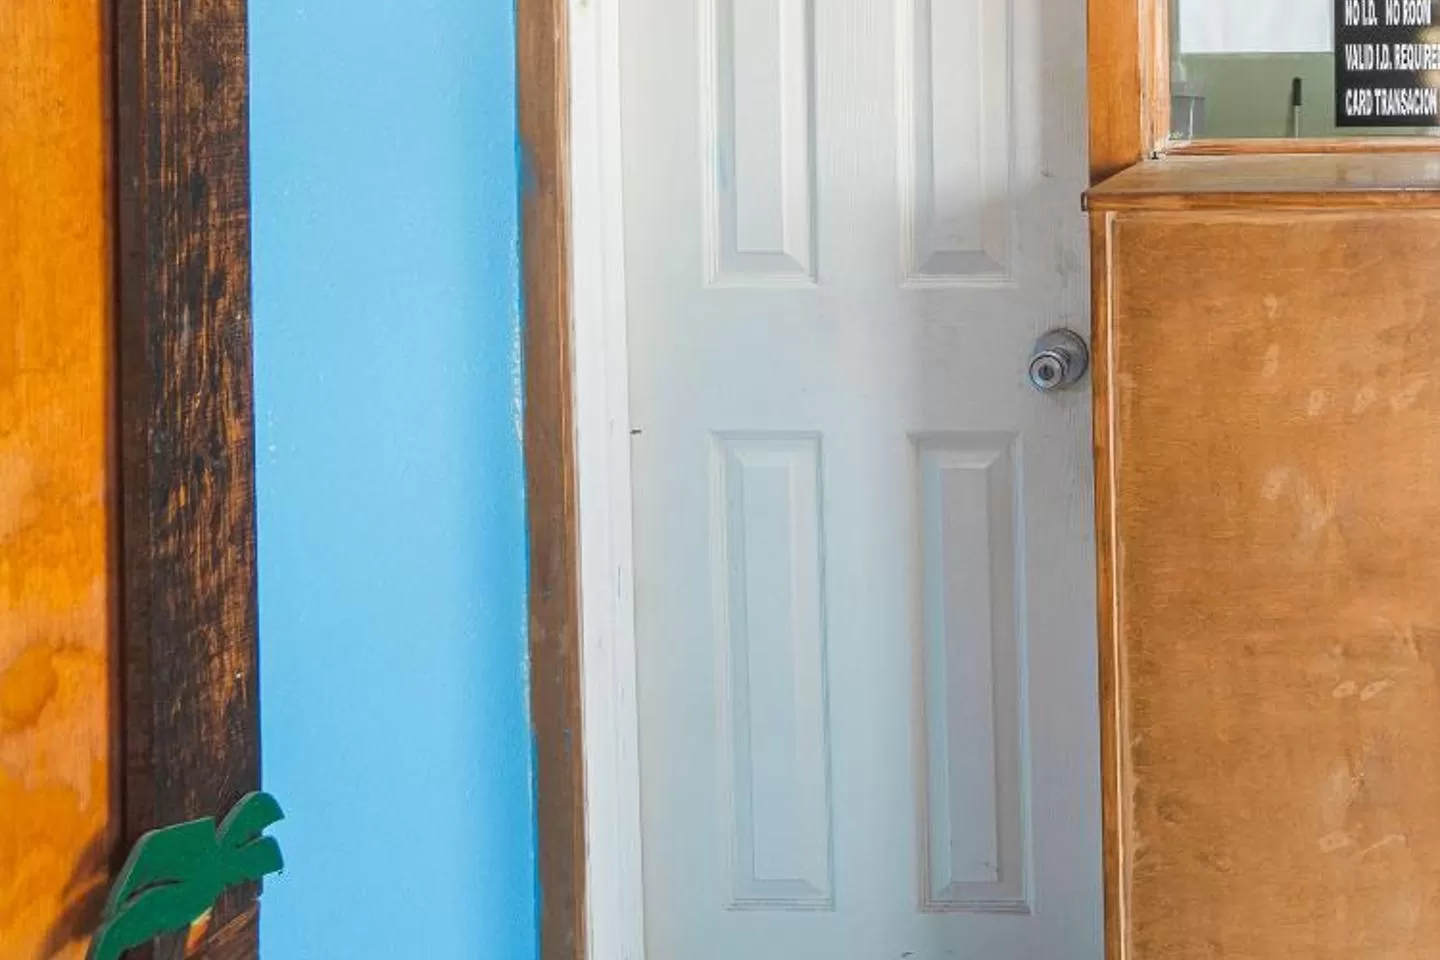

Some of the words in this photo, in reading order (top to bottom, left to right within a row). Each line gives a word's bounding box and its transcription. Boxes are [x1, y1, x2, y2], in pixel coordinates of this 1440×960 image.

[1385, 0, 1400, 26] NO
[1345, 44, 1374, 71] VALID
[1376, 43, 1393, 70] I.D.
[1345, 88, 1373, 116] CARD
